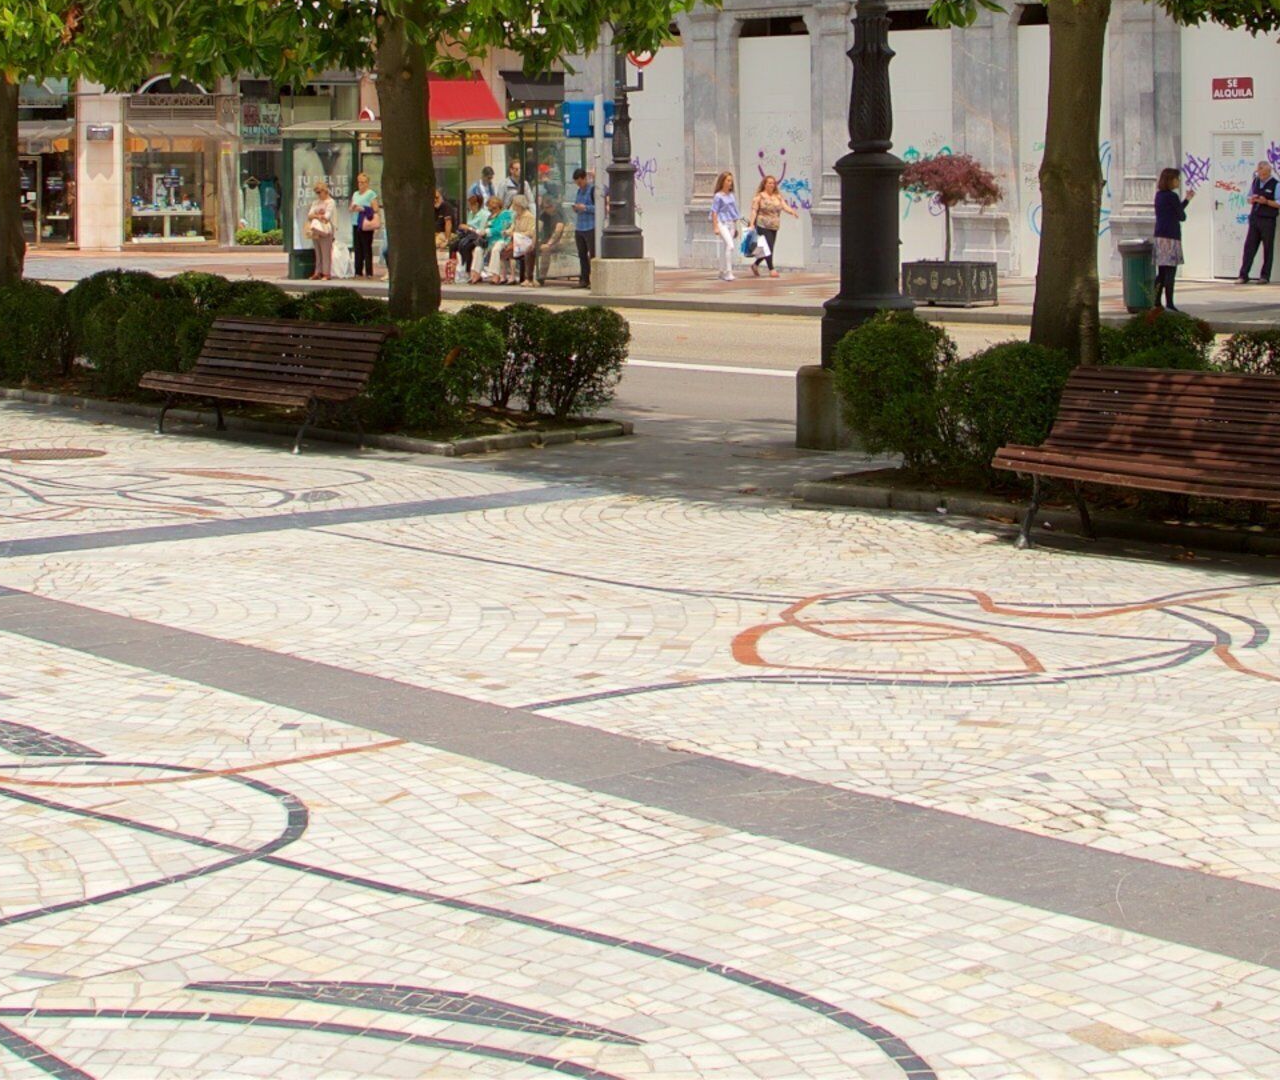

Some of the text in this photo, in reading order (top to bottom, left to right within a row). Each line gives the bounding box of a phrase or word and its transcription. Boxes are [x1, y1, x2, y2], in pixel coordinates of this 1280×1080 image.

[1227, 79, 1238, 88] SE
[1214, 88, 1253, 98] ALQUILA
[298, 176, 310, 185] TU
[336, 176, 348, 185] TE
